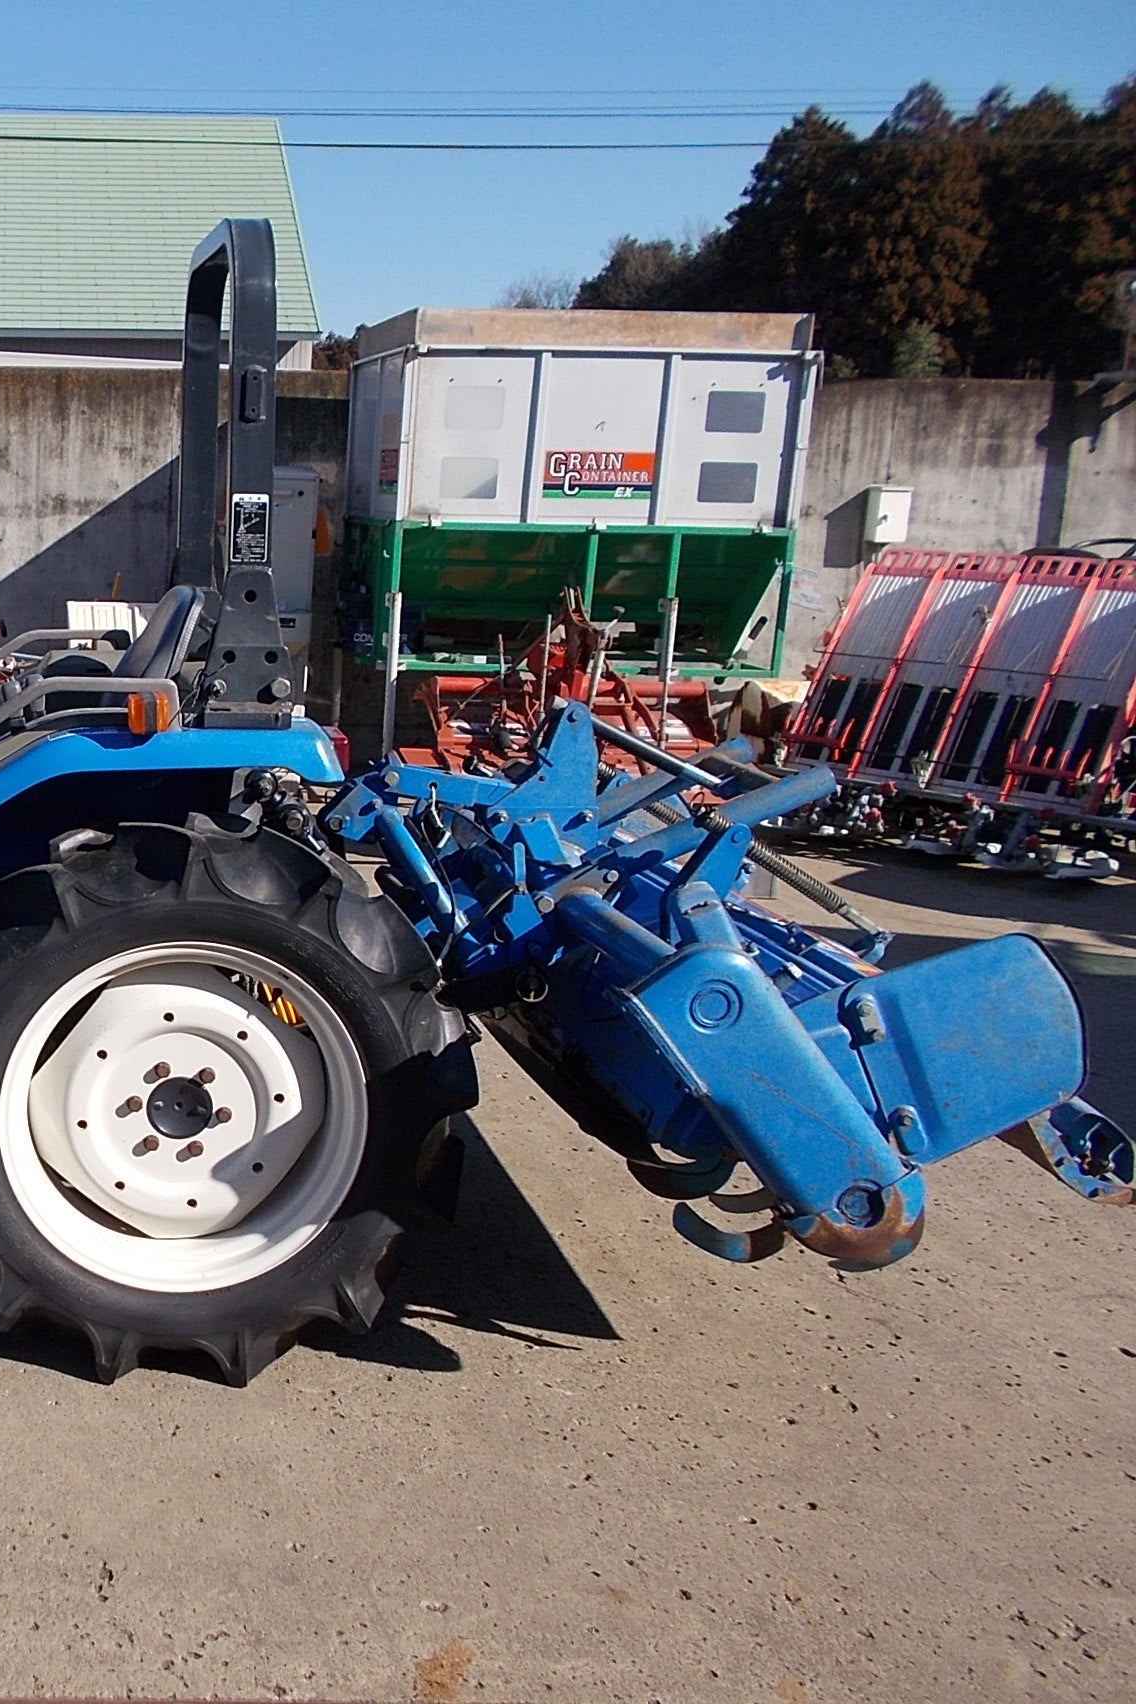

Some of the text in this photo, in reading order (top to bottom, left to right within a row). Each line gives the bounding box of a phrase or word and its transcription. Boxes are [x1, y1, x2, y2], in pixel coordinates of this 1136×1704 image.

[549, 452, 624, 477] GRAIN
[562, 471, 649, 496] CONTAINER
[613, 486, 635, 498] EX
